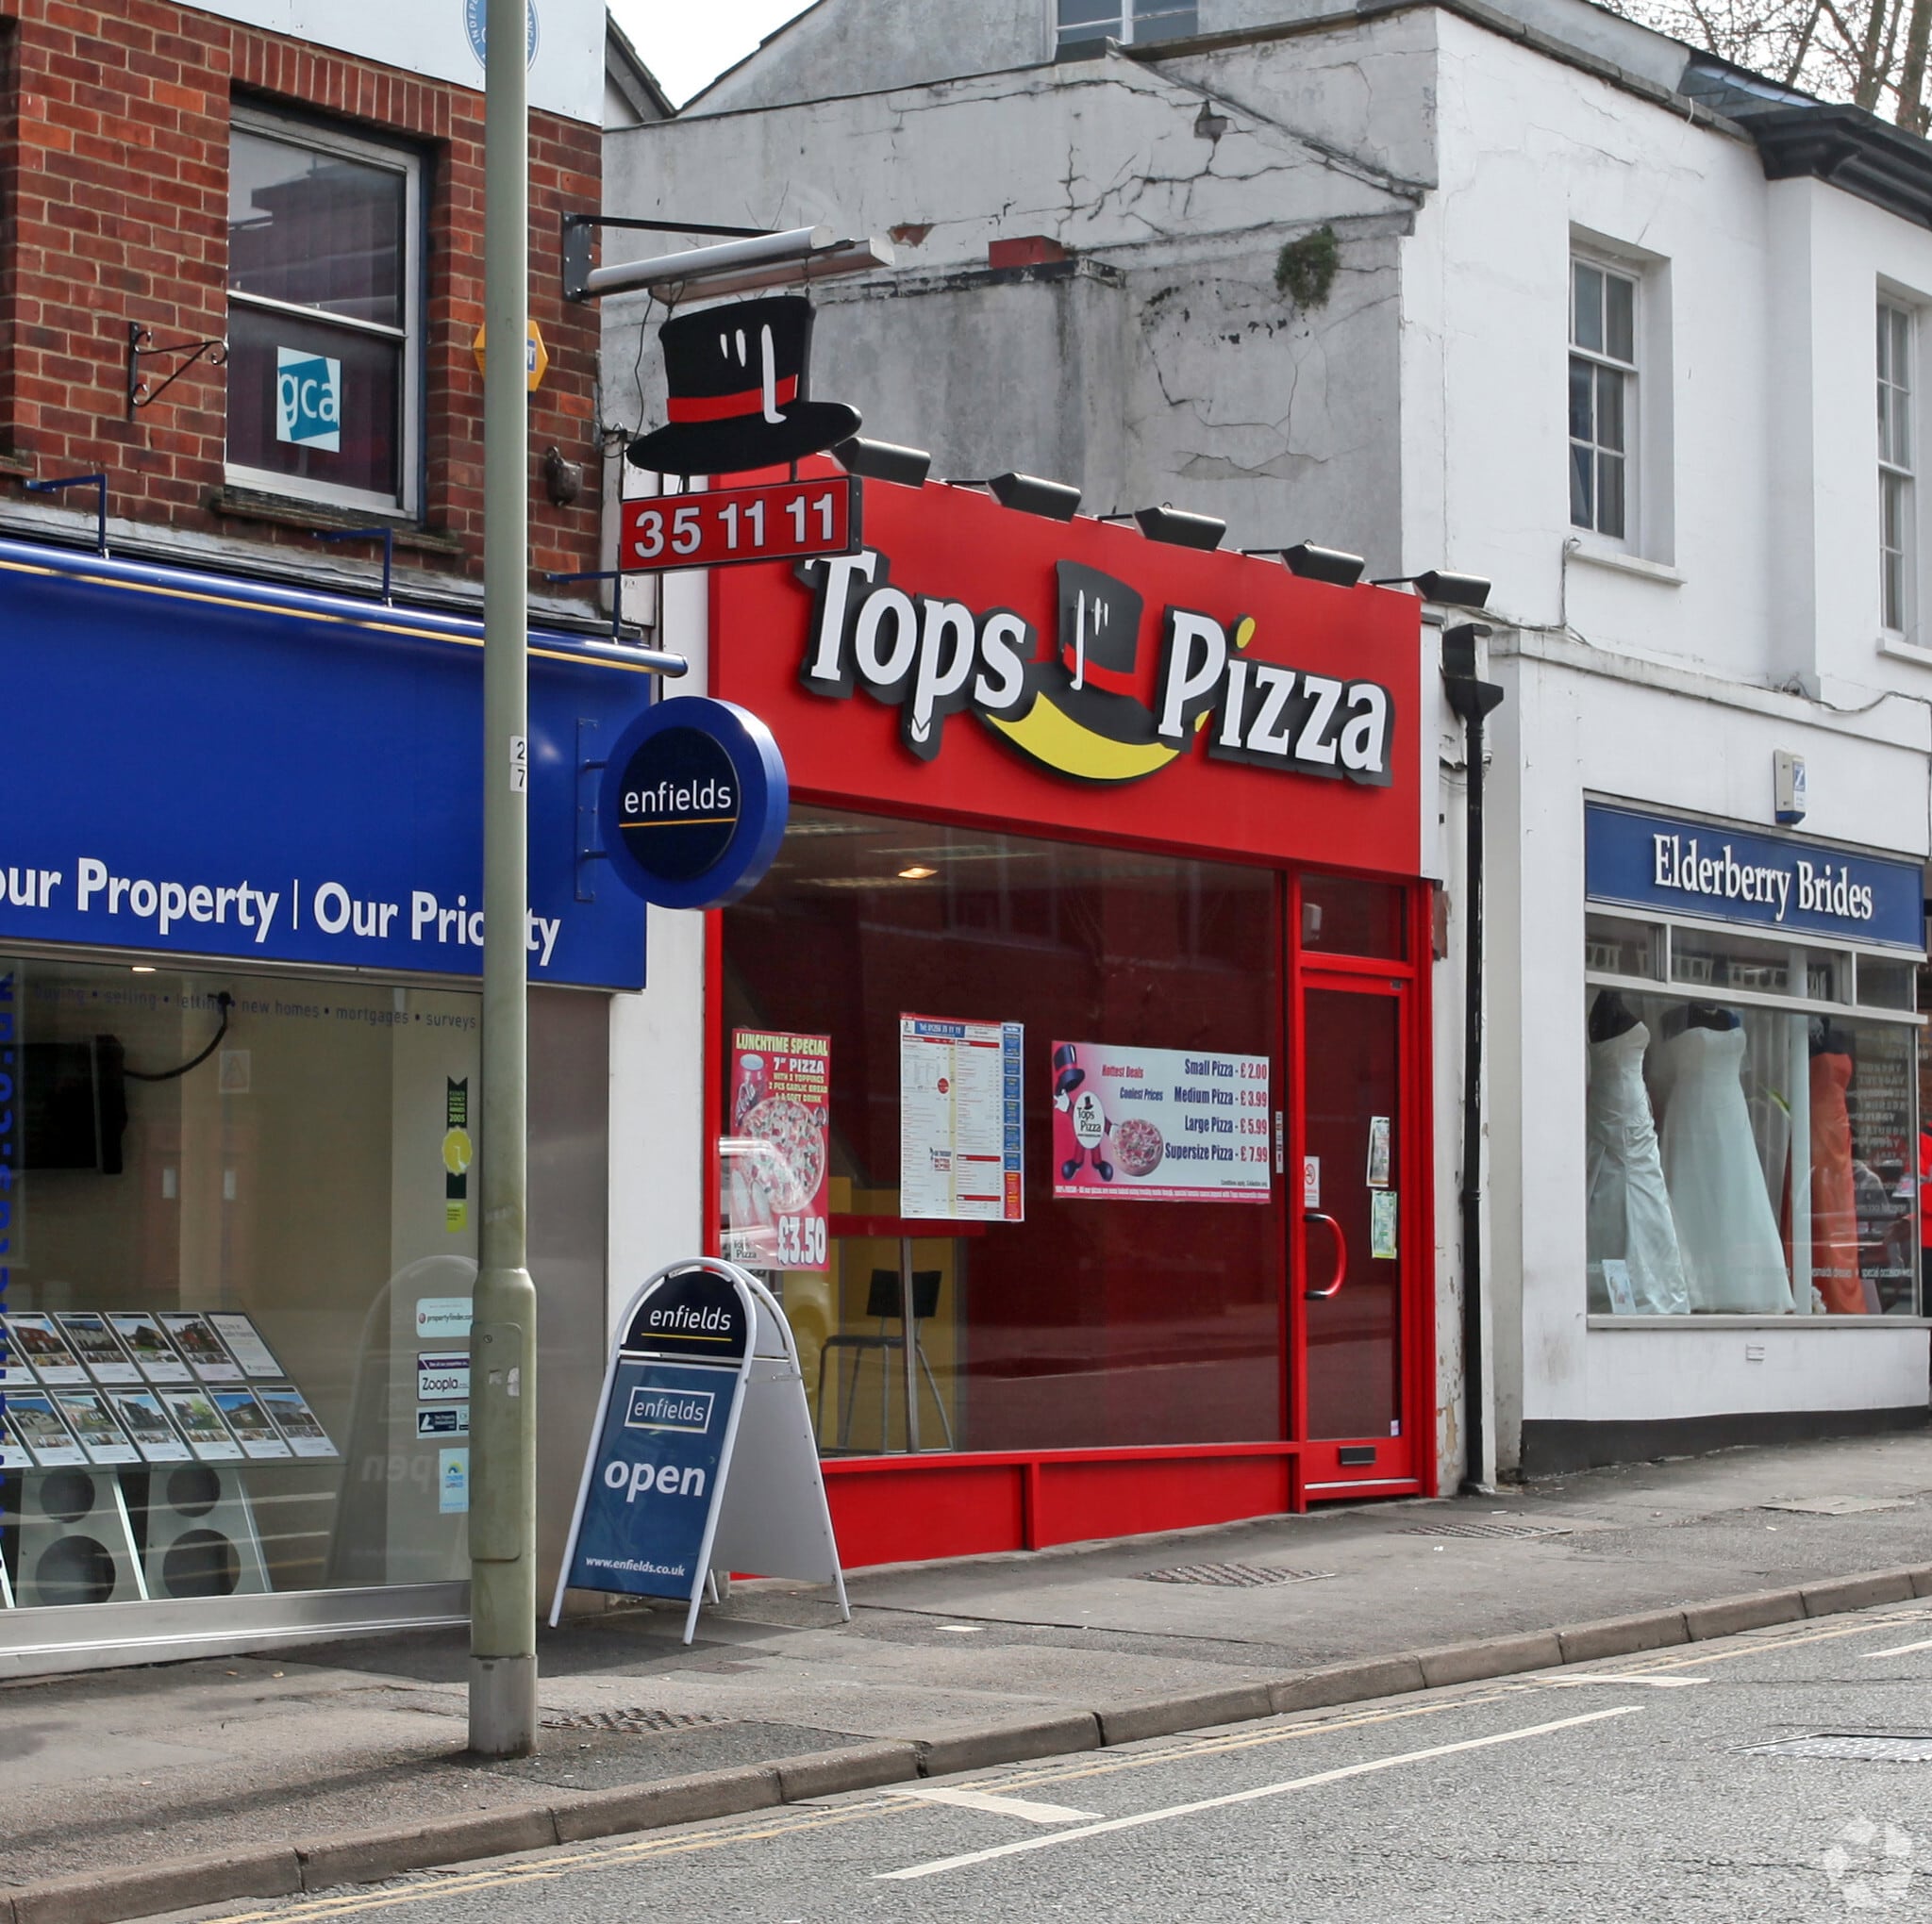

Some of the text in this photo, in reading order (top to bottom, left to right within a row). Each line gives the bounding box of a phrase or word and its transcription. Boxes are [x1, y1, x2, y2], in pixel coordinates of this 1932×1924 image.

[279, 373, 337, 427] gca
[634, 492, 833, 558] 35 11 11
[805, 551, 1387, 773] Tops Pizza
[517, 741, 525, 759] 2
[518, 769, 525, 788] 7
[625, 778, 731, 814] enfields
[1653, 834, 1873, 921] Elderberry Brides
[0, 867, 62, 907] ur
[77, 857, 279, 943] Property
[314, 882, 398, 937] Our
[106, 989, 157, 1010] selling
[242, 999, 269, 1014] new
[276, 1000, 319, 1019] homes
[336, 1005, 408, 1026] mortgages
[426, 1013, 476, 1031] surveys
[736, 1033, 828, 1056] LUNCHTIME SPECIAL
[790, 1057, 825, 1074] PIZZA
[1185, 1058, 1209, 1075] Small
[1211, 1060, 1233, 1077] Pizza
[1174, 1086, 1209, 1103] Medium
[1211, 1088, 1233, 1105] Pizza
[1077, 1106, 1094, 1120] Tops
[1185, 1115, 1209, 1134] Large
[1211, 1117, 1233, 1133] Pizza
[1080, 1120, 1101, 1132] Pizza
[1165, 1142, 1209, 1160] Supersize
[1211, 1144, 1233, 1161] Pizza
[777, 1215, 826, 1265] £3.50
[649, 1304, 731, 1331] enfields
[422, 1377, 458, 1392] Zoopla
[634, 1398, 705, 1422] enfields
[604, 1459, 706, 1502] open
[586, 1557, 686, 1577] www.enfields.co.uk
